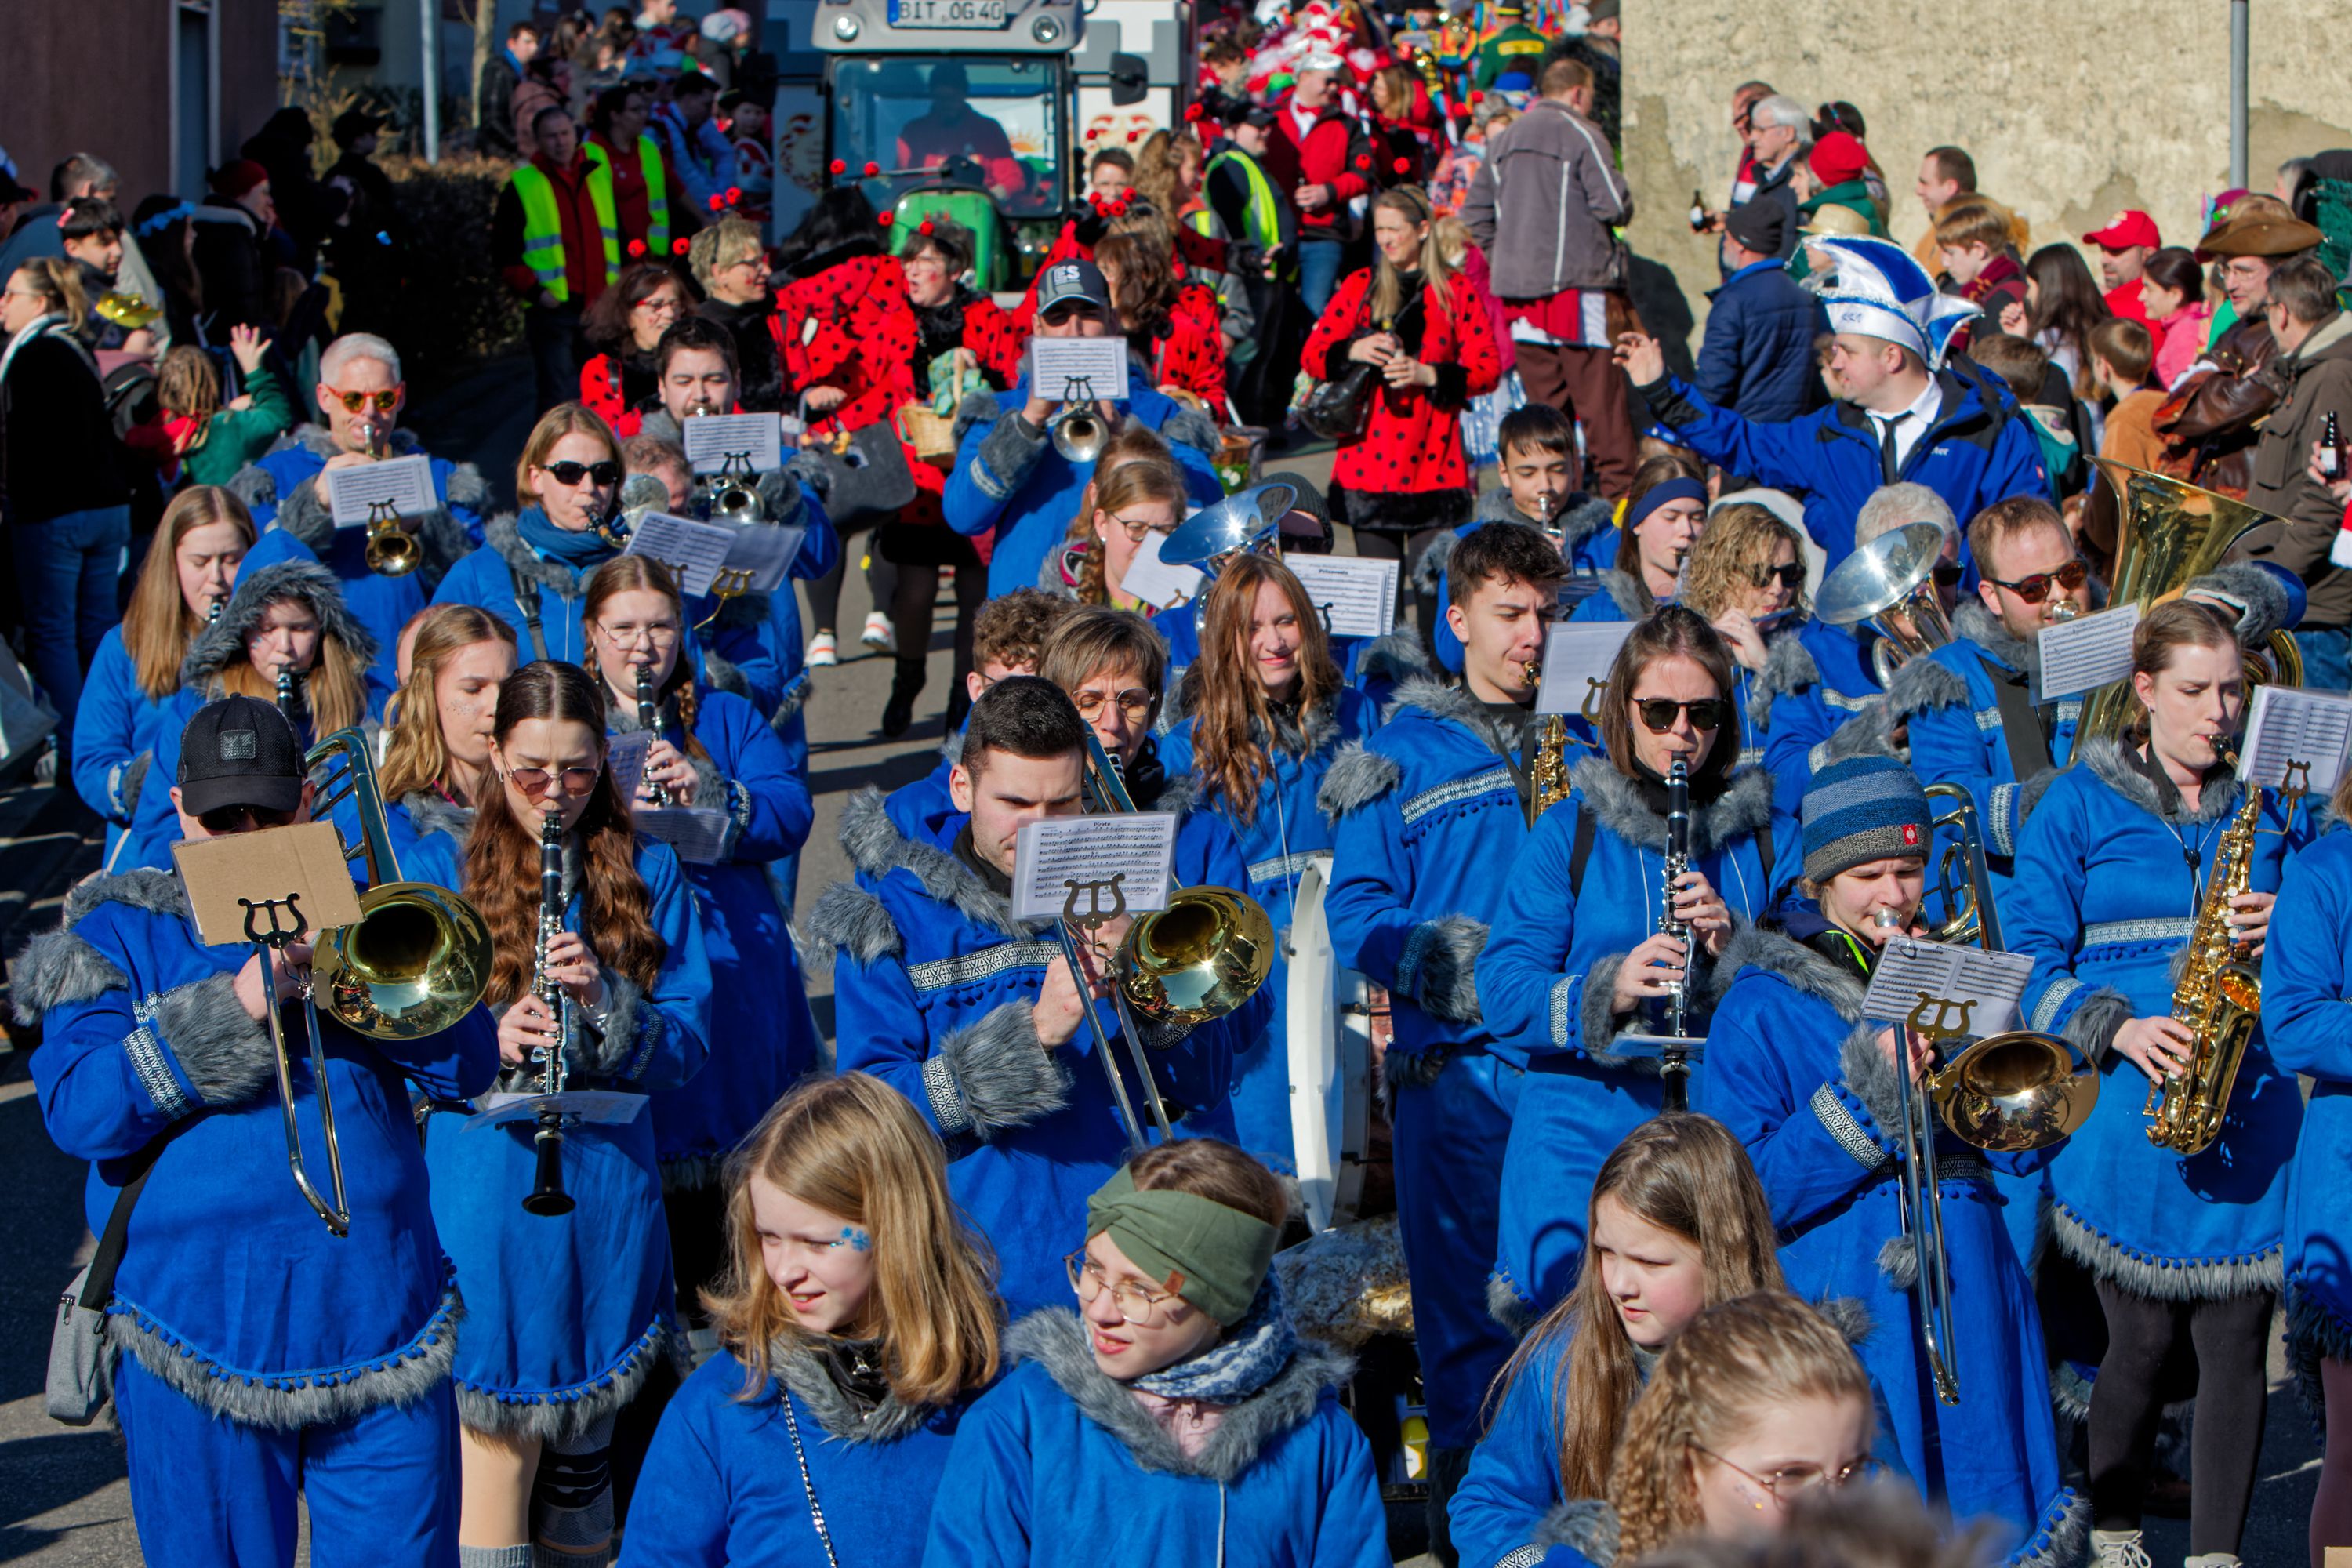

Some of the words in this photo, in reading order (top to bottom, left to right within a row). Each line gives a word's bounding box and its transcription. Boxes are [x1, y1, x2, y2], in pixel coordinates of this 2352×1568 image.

[901, 2, 935, 19] BIT
[949, 2, 974, 20] OG
[979, 2, 1001, 20] 40
